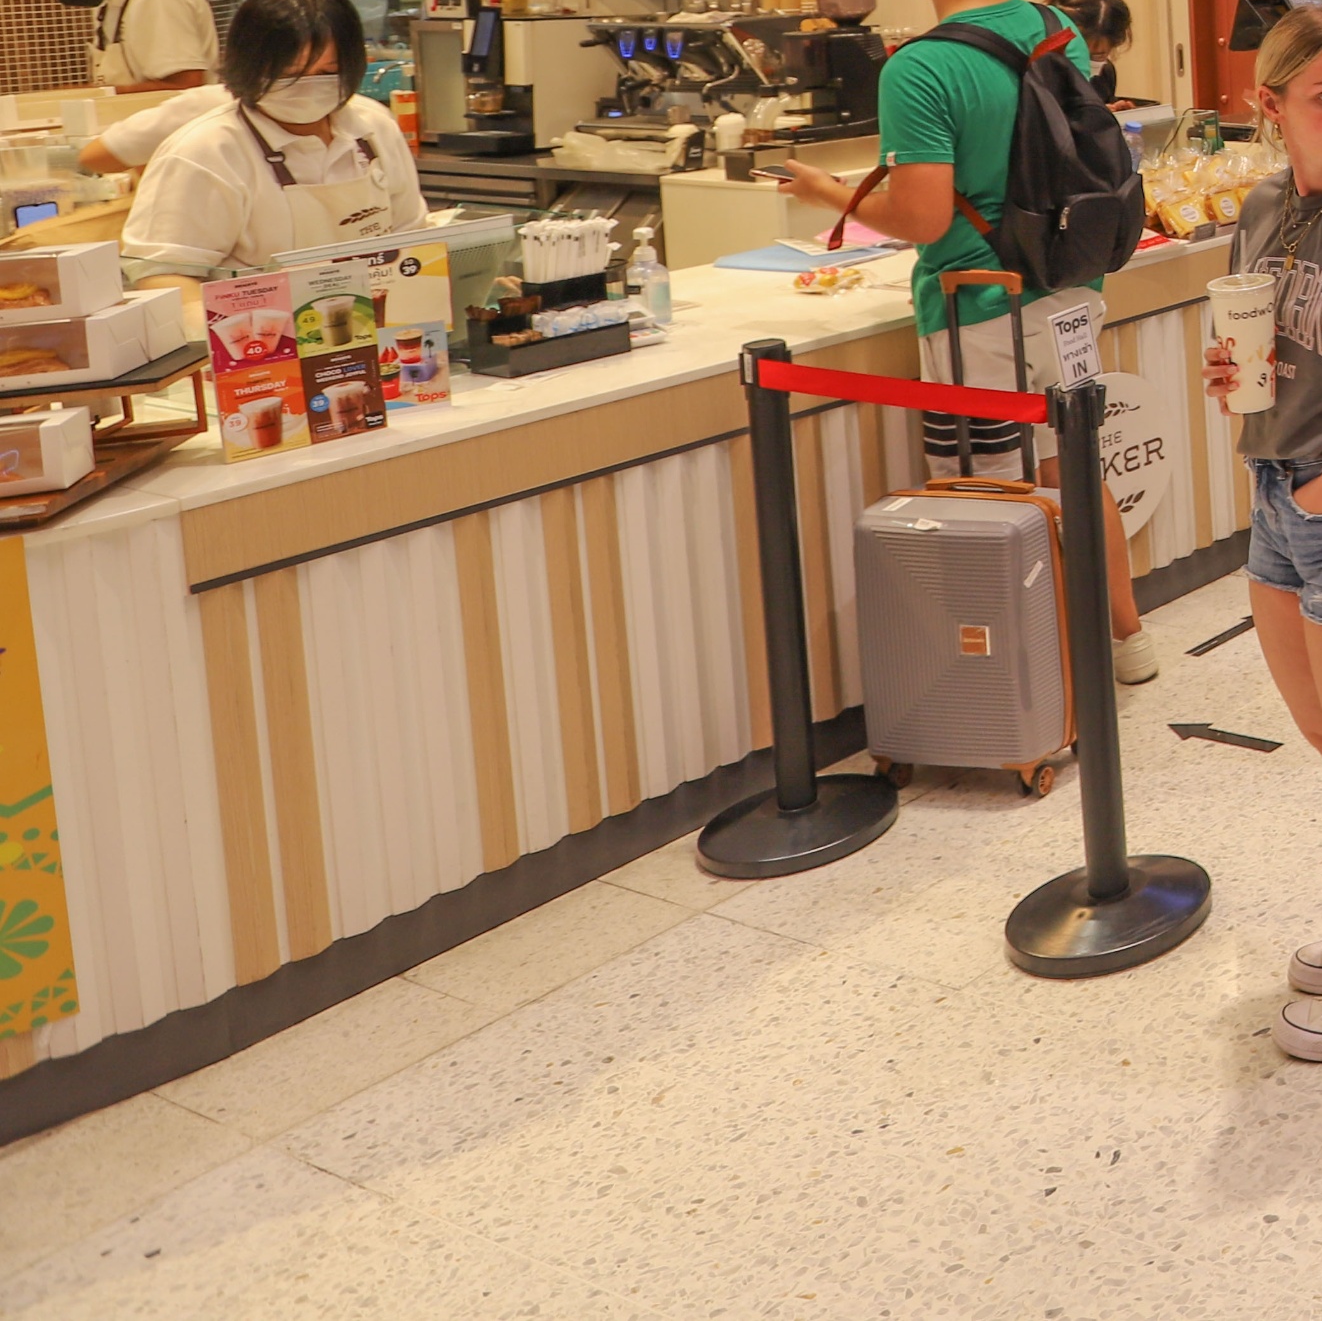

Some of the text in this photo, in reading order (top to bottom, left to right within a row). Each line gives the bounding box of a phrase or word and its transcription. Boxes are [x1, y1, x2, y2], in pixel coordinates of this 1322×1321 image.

[402, 265, 418, 276] 39
[242, 285, 278, 297] TUESDAY
[1055, 314, 1089, 335] Tops
[354, 333, 373, 342] Tops
[314, 368, 342, 379] CHOCO
[1072, 359, 1088, 378] IN
[1275, 362, 1297, 380] OAST
[234, 380, 287, 396] THURSDAY
[415, 391, 447, 404] Tops
[1100, 430, 1122, 449] HE
[1099, 437, 1165, 482] KER
